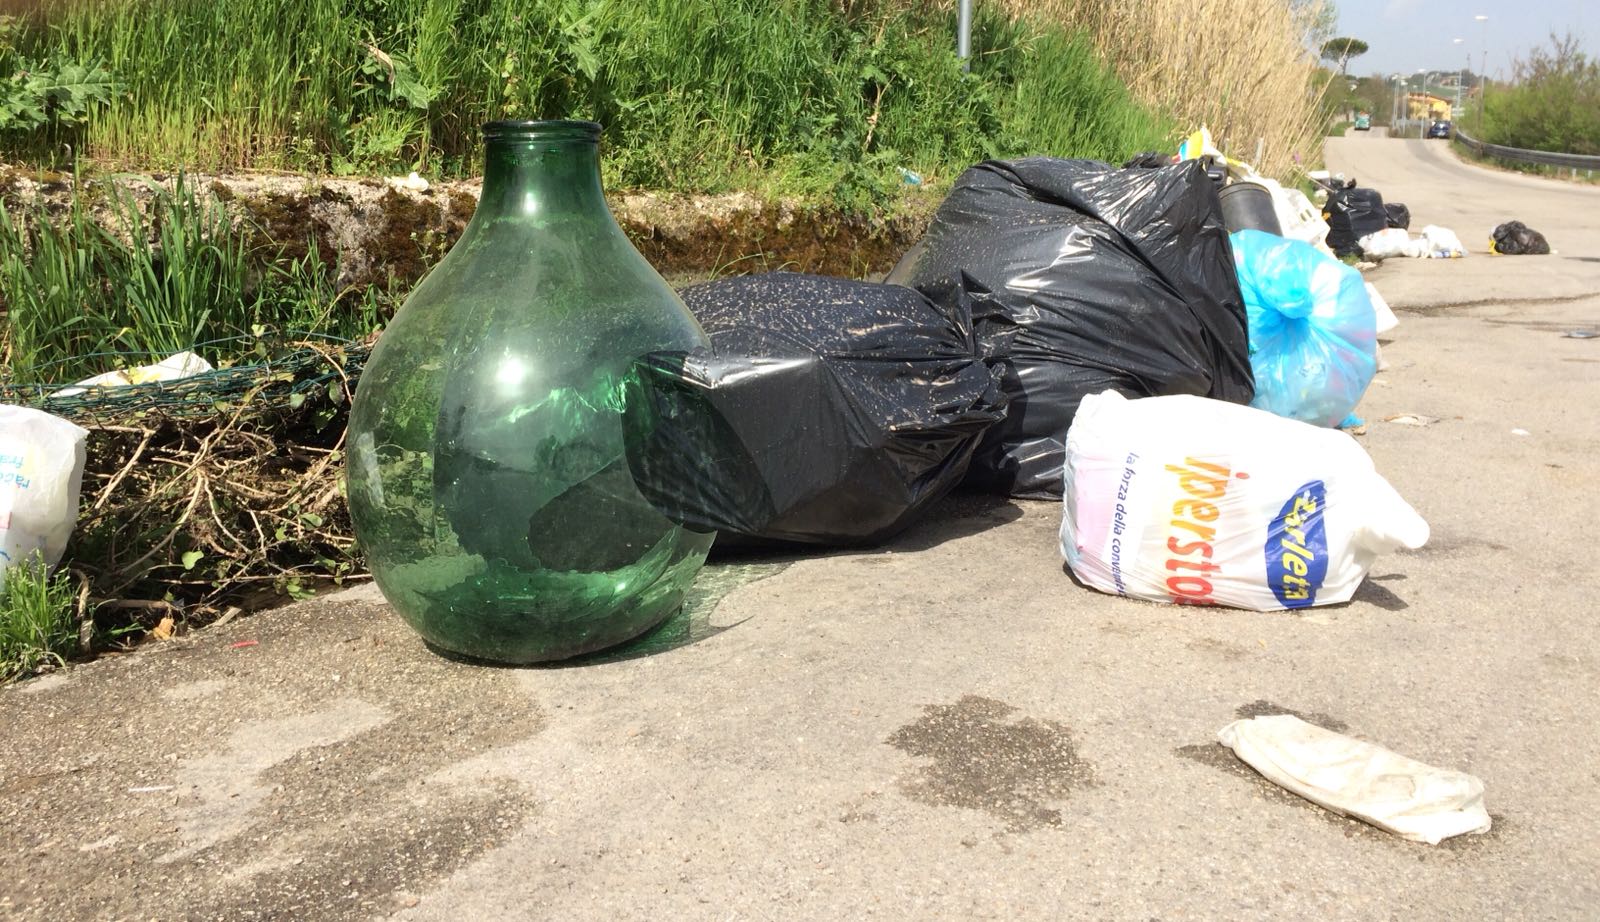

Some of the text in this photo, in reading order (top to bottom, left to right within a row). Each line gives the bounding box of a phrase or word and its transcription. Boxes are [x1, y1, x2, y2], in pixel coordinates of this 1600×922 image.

[1126, 452, 1140, 465] la
[1117, 467, 1136, 500] forza
[1113, 503, 1127, 536] della
